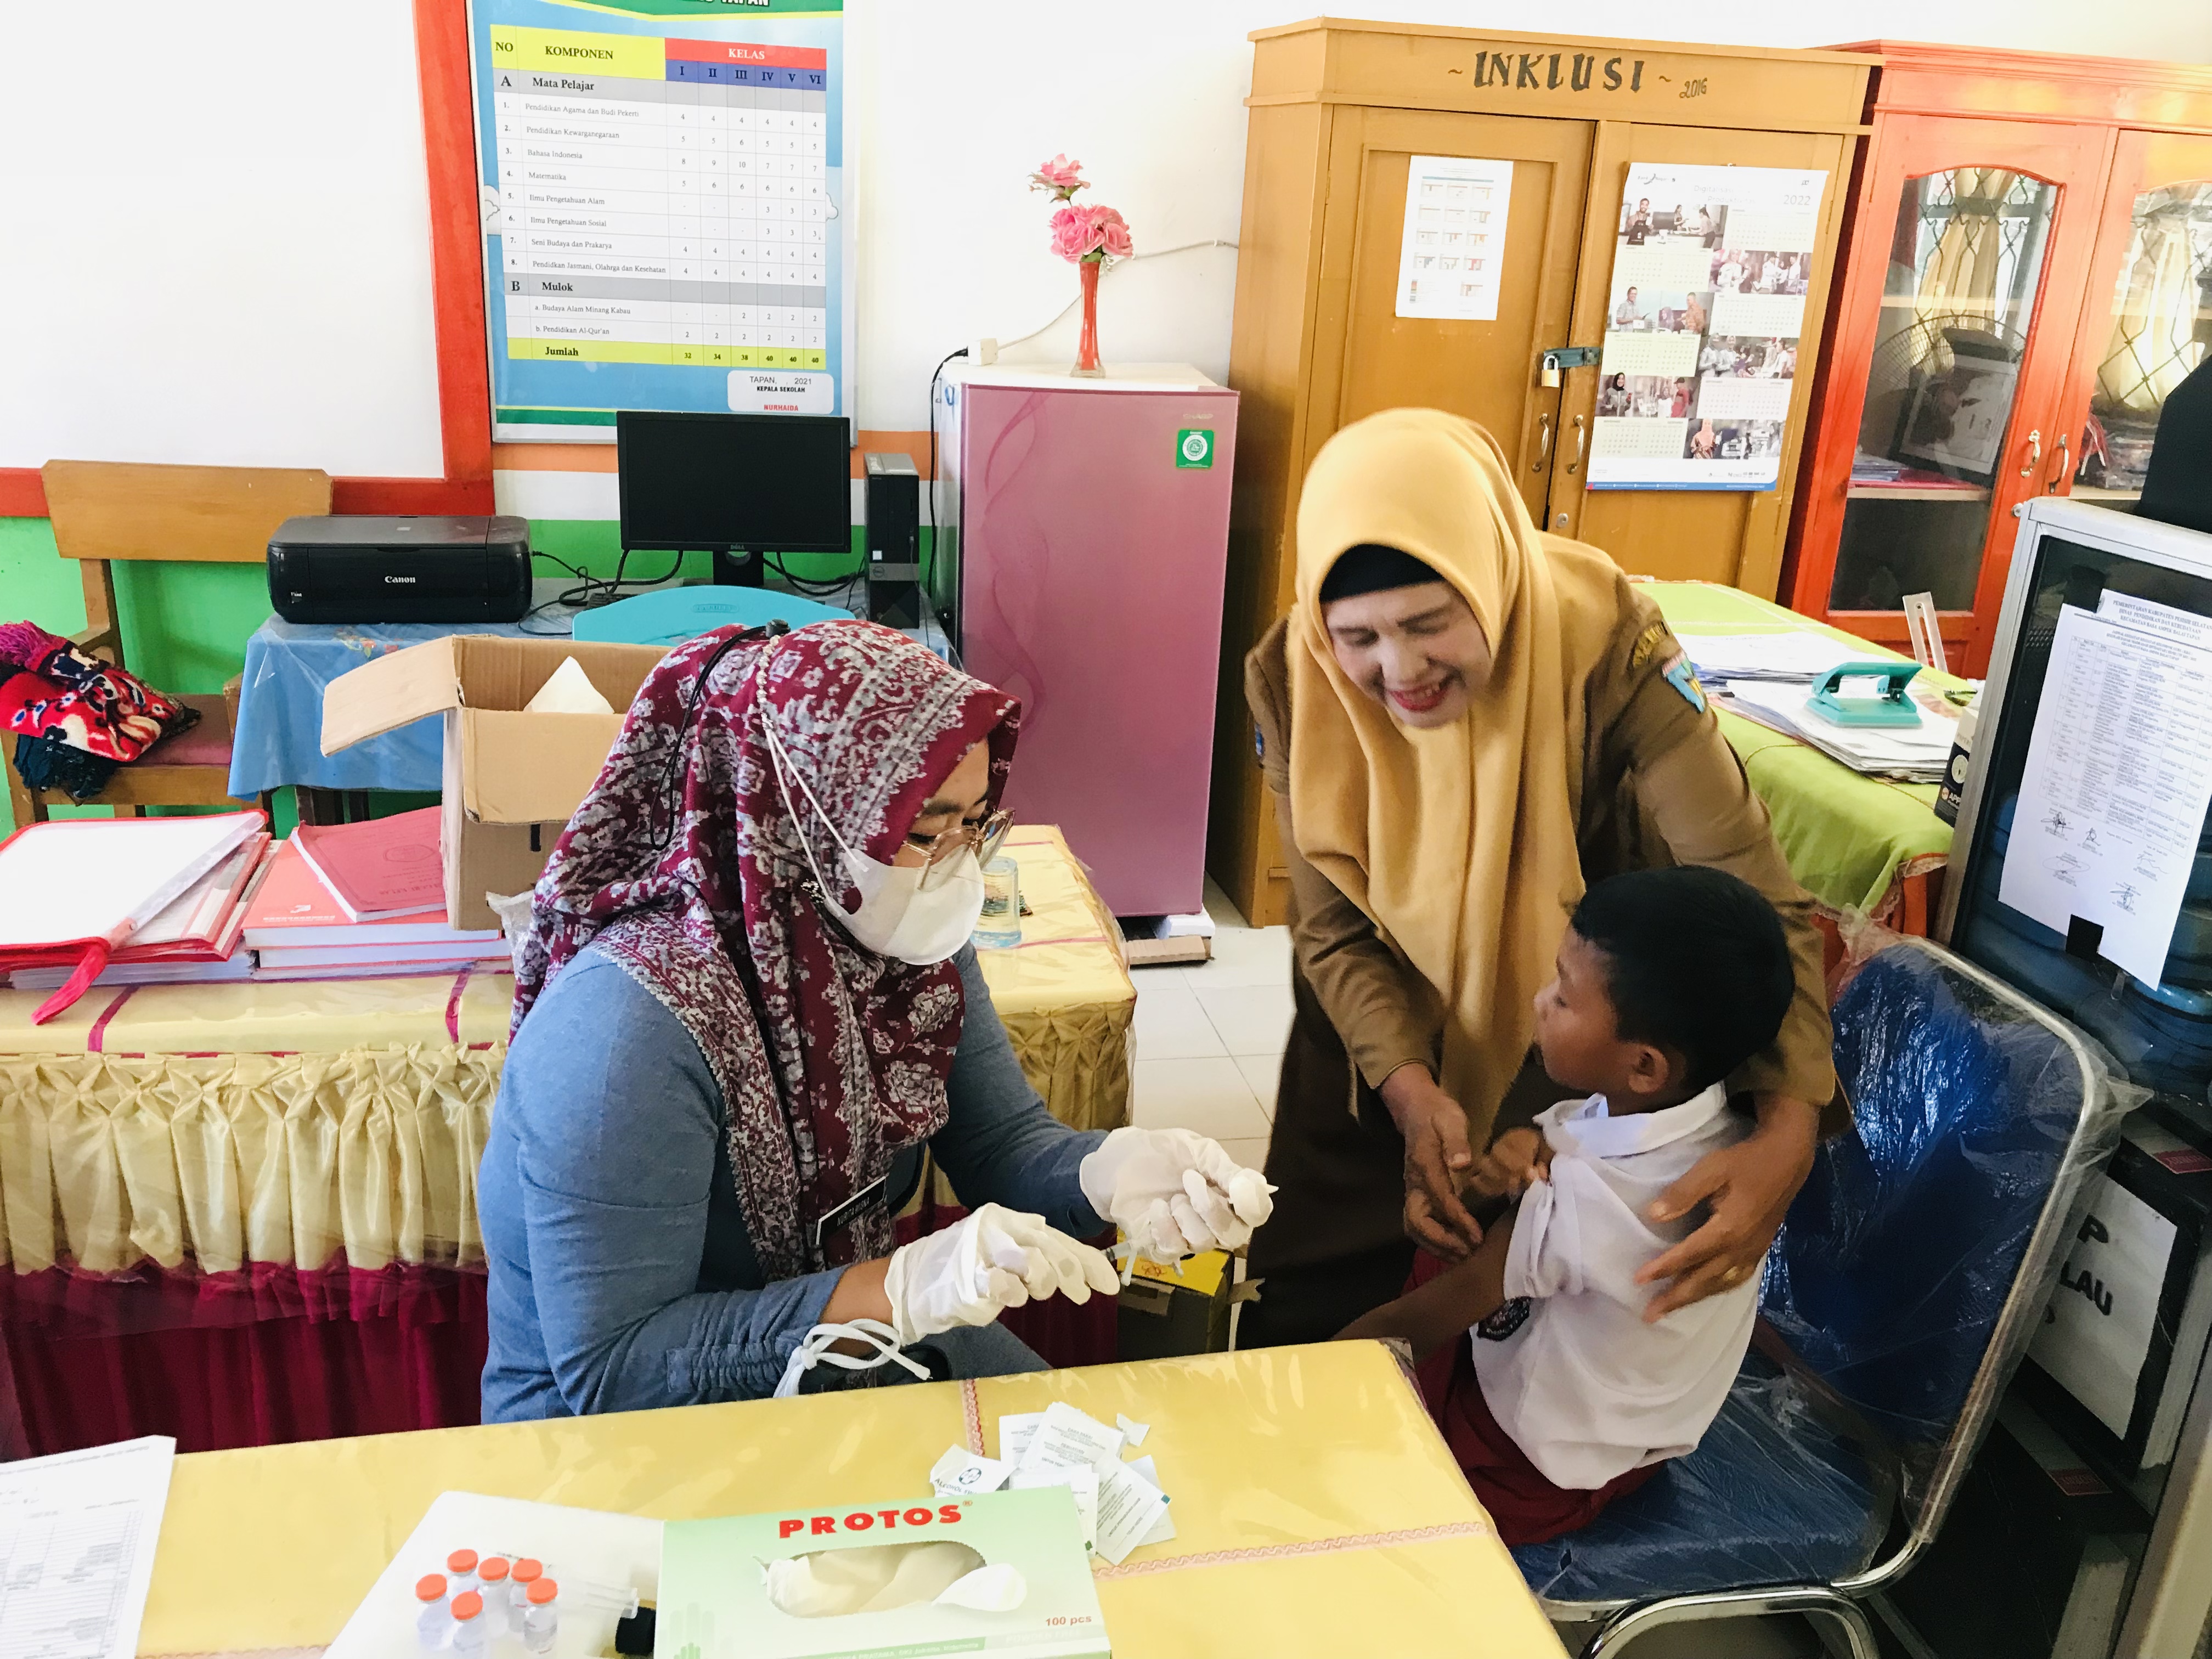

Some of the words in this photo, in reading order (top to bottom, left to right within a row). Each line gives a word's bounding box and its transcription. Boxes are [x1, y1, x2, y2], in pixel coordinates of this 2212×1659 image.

[496, 42, 513, 52] NO
[546, 46, 612, 59] KOMPONEN
[729, 48, 765, 59] KELAS
[680, 66, 684, 75] I
[709, 69, 716, 77] II
[735, 70, 747, 79] III
[762, 72, 774, 81] IV
[788, 74, 795, 82] V
[809, 75, 821, 84] VI
[1474, 51, 1645, 93] INKLUSI
[501, 76, 511, 86] A
[533, 77, 558, 87] Mata
[562, 80, 594, 92] Pelajar
[1679, 77, 1708, 99] 2016
[526, 103, 561, 111] Pendidikan
[527, 126, 562, 134] Pendidikan
[564, 129, 619, 139] Kewarganegaraan
[1783, 194, 1811, 206] 2022
[585, 241, 612, 250] Prakarya
[512, 281, 520, 291] B
[543, 282, 573, 291] Mulok
[545, 347, 578, 356] Jumlah
[384, 575, 416, 584] Canon
[934, 1478, 962, 1492] ALCOHOL
[779, 1504, 962, 1538] PROTOS
[1046, 1616, 1066, 1627] 100
[1070, 1615, 1092, 1626] pcs
